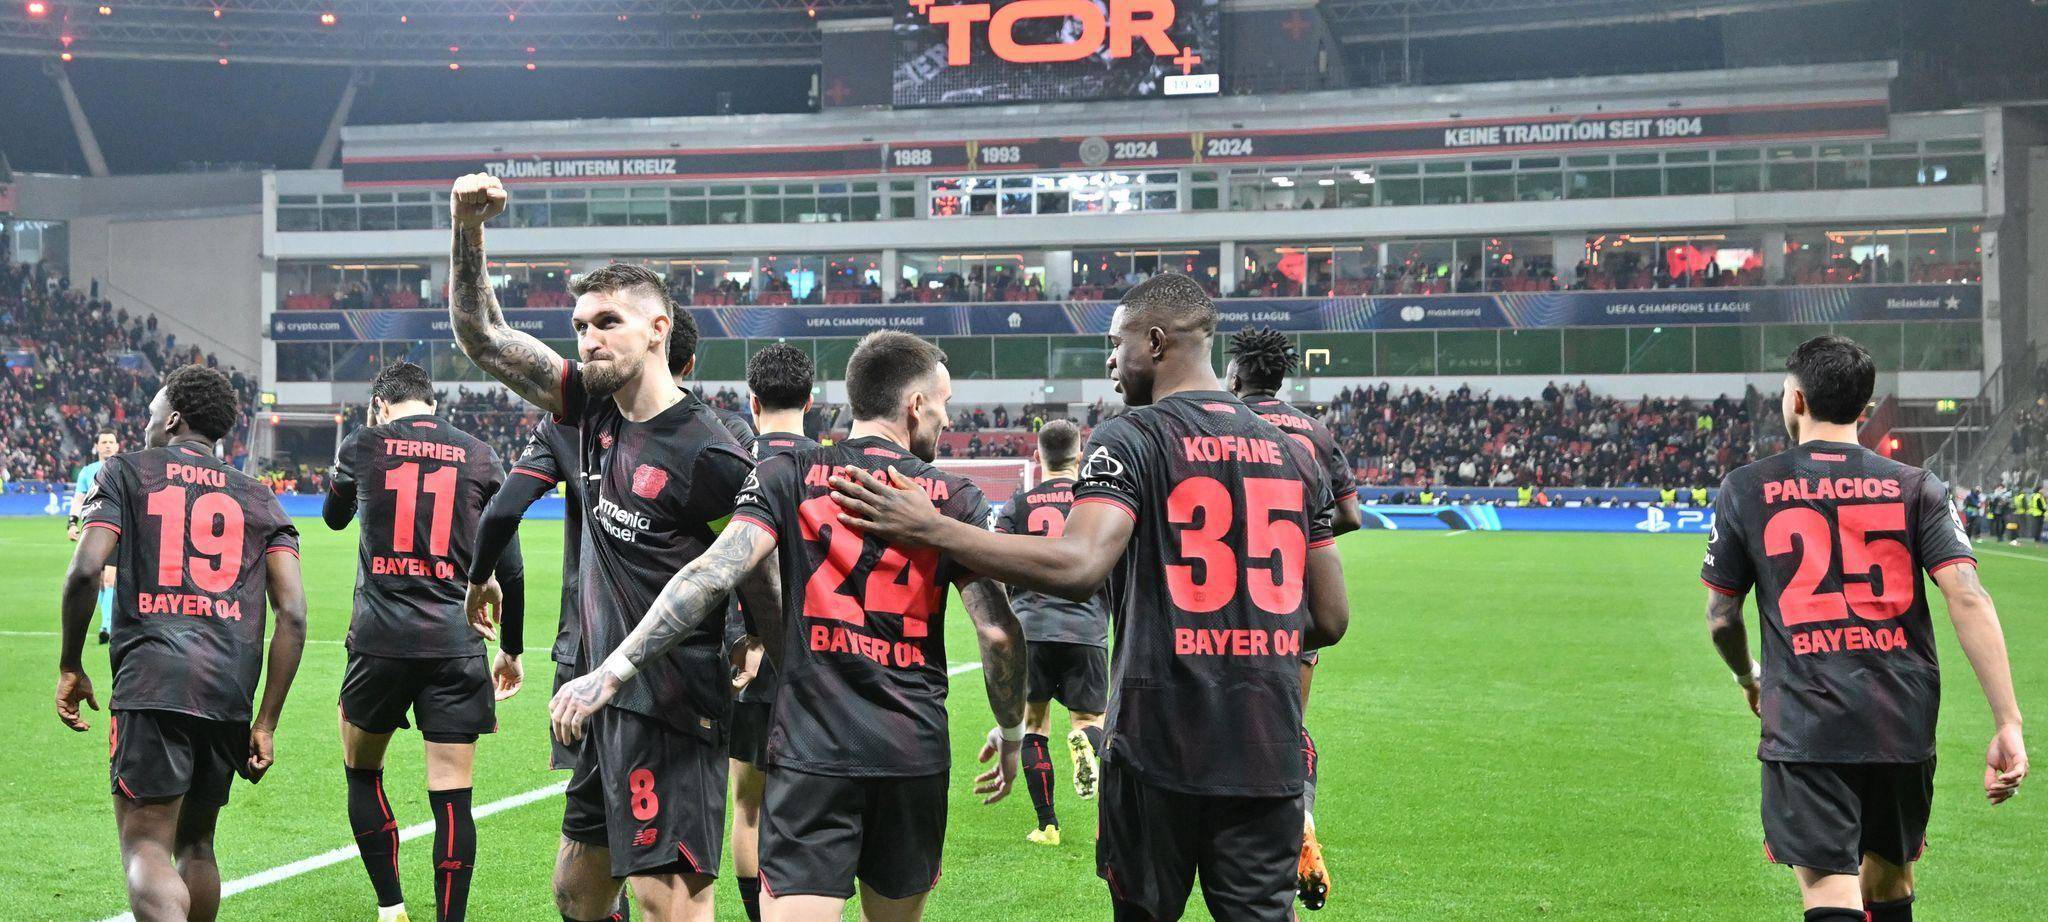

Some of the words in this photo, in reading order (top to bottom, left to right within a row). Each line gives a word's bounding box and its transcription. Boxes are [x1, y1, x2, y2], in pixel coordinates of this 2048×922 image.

[929, 0, 1180, 66] TOR
[1444, 127, 1500, 147] KEINE
[1503, 121, 1606, 144] TRADITION
[1609, 119, 1653, 139] SEIT
[1656, 117, 1702, 137] 1904
[894, 149, 932, 166] 1988
[982, 146, 1020, 164] 1993
[1114, 142, 1158, 160] 2024
[1208, 138, 1252, 156] 2024
[484, 159, 551, 178] TRÄUME
[554, 159, 620, 177] UNTERM
[622, 158, 676, 175] KREUZ
[1252, 311, 1291, 321] LEAGUE
[1426, 308, 1481, 317] mastercard
[1605, 304, 1636, 315] UEFA
[1638, 303, 1705, 314] CHAMPIONS
[1707, 302, 1751, 313] LEAGUE
[287, 321, 340, 331] crypto.com
[432, 322, 452, 330] UEF
[806, 317, 831, 327] UEFA
[833, 317, 886, 326] CHAMPIONS
[889, 316, 925, 326] LEAGUE
[384, 438, 466, 463] TERRIER
[1183, 435, 1283, 466] KOFANE
[166, 463, 226, 488] POKU
[1763, 477, 1901, 504] PALACIOS
[385, 461, 458, 557] 11
[147, 484, 245, 593] 19
[1165, 476, 1307, 615] 35
[372, 556, 432, 577] BAYER
[435, 561, 455, 580] 04
[798, 494, 942, 638] 24
[1763, 502, 1914, 628] 25
[138, 592, 213, 617] BAYER
[214, 599, 242, 621] 04
[810, 625, 891, 667] BAYER
[893, 642, 926, 668] 04
[1175, 628, 1269, 657] BAYER
[1273, 628, 1300, 656] 04
[1875, 626, 1908, 652] 04
[629, 770, 660, 821] 8
